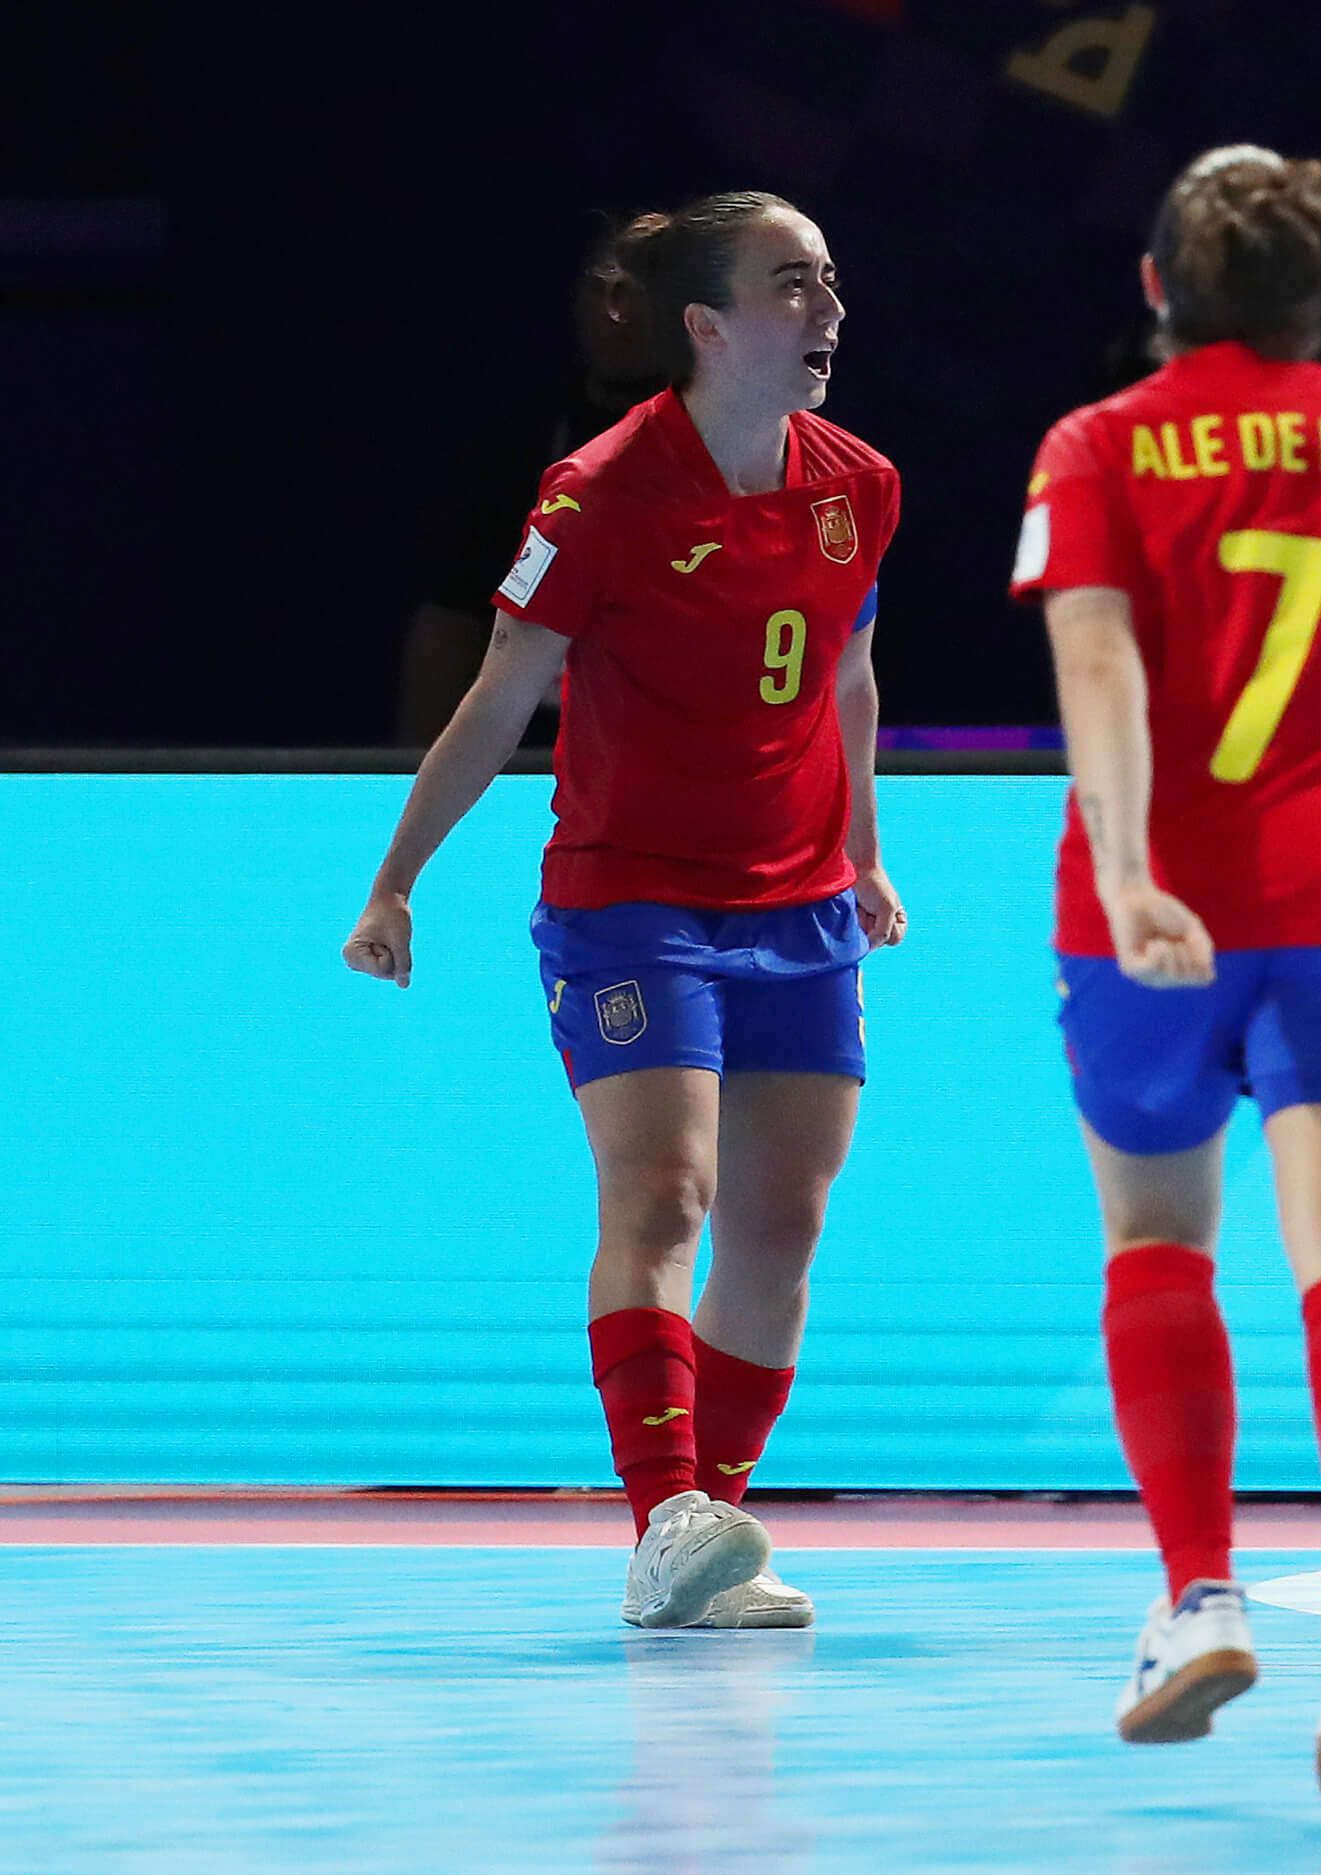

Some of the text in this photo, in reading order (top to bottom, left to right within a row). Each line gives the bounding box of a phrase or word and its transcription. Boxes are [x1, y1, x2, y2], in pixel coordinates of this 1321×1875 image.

[1132, 415, 1230, 481] ALE
[1237, 412, 1308, 473] DE
[759, 609, 807, 705] 9
